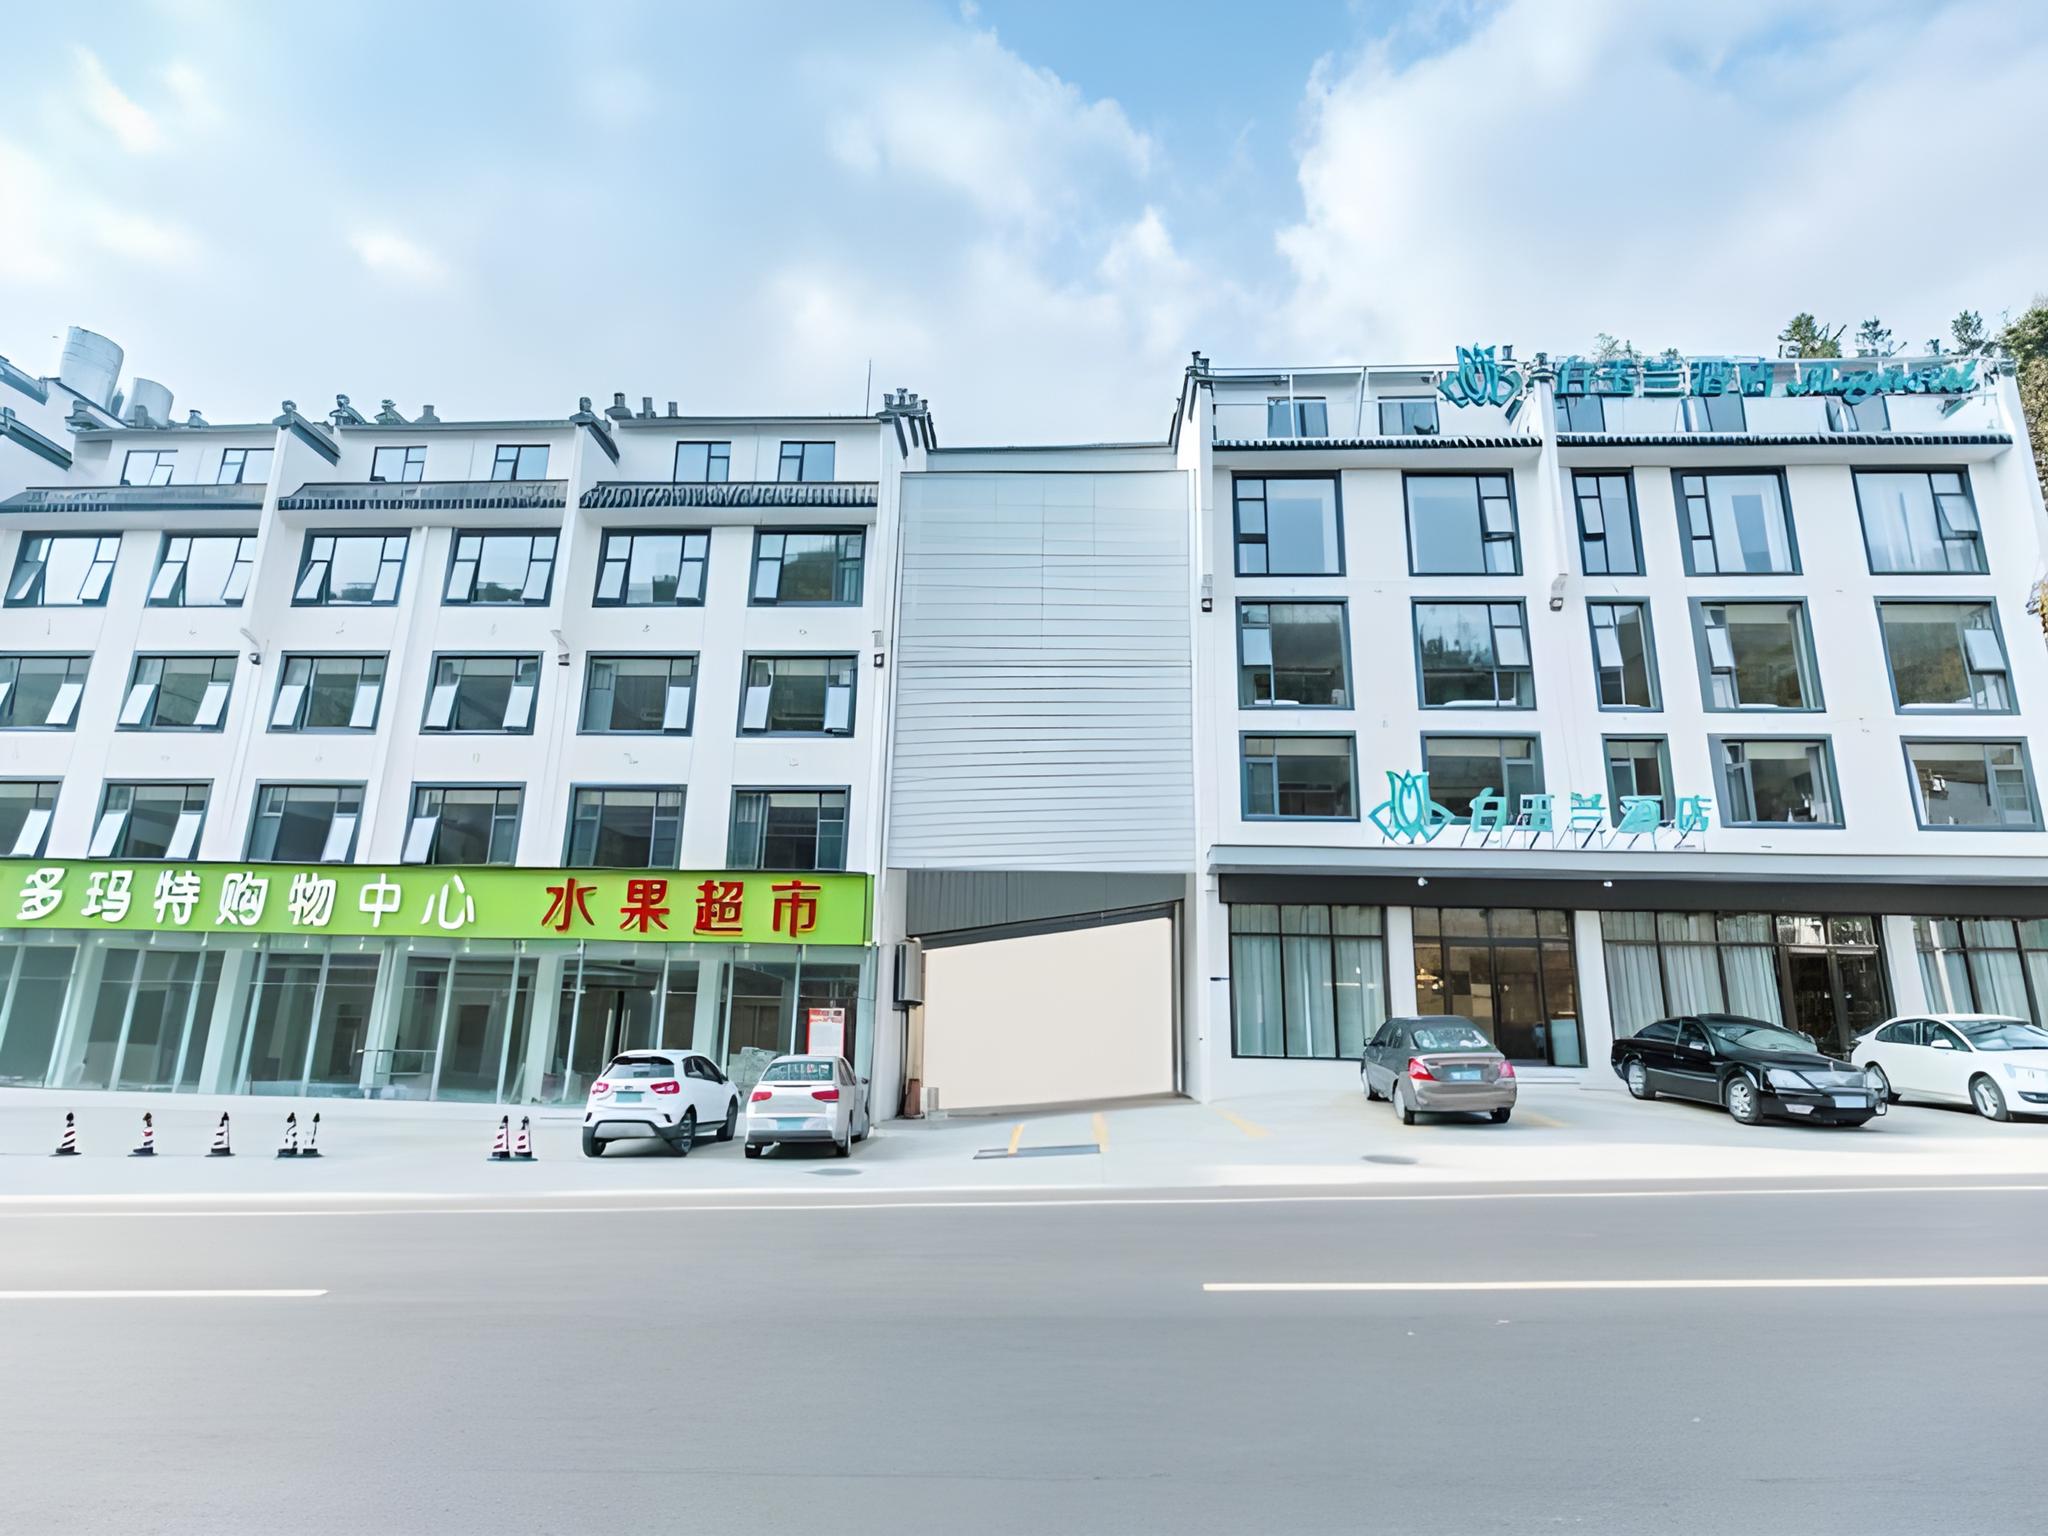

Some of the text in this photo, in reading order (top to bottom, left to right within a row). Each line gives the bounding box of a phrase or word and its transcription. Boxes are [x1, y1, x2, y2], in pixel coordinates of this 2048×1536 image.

[16, 867, 822, 938] 多玛特购物中心 水果超市
